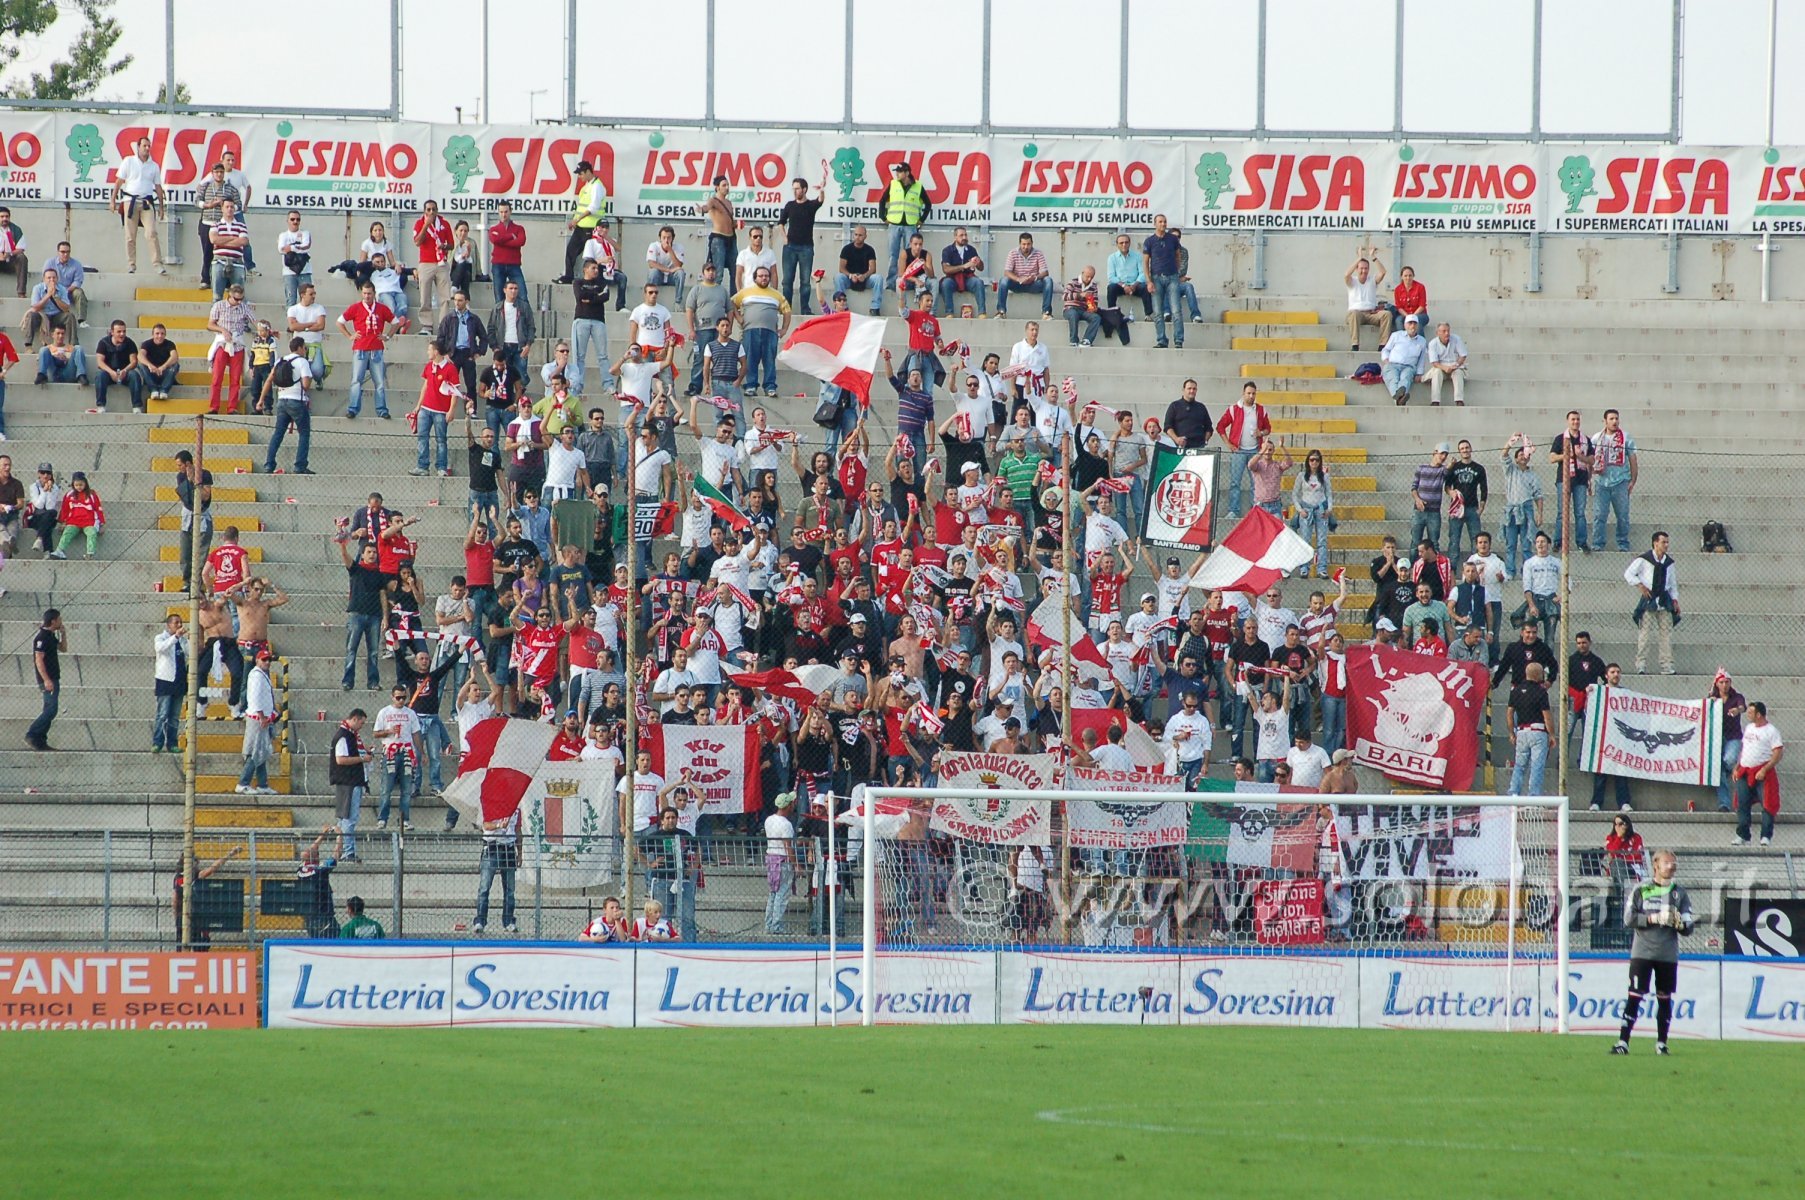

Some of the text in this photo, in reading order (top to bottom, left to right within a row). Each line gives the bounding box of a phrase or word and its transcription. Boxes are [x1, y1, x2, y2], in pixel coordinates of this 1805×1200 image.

[482, 138, 615, 197] SISA
[8, 171, 37, 183] SISA
[1233, 154, 1365, 211] SISA
[65, 187, 69, 199] I
[332, 181, 413, 194] gruppo SISA
[1596, 158, 1729, 215] SISA
[265, 194, 418, 210] LA SPESA PIÙ SEMPLICE
[701, 190, 782, 203] grpo SISA
[1073, 197, 1149, 209] gruppo SISA
[637, 205, 652, 216] LA
[657, 205, 696, 217] SPESA
[734, 207, 782, 219] EMPLIC
[938, 209, 991, 221] ITALIANI
[1451, 203, 1531, 214] gruppo SISA
[1013, 210, 1153, 224] LA SPESA PIÙ SEMPLICE
[1194, 214, 1364, 228] I SUPERMERCATI ITALIANI
[1388, 216, 1536, 230] LA SPESA PIÙ SEMPLICE
[1556, 218, 1728, 231] I SUPERMERCATI ITALIANI
[1753, 221, 1768, 231] LA
[1153, 539, 1201, 552] SANTERAMO
[1609, 696, 1702, 721] QUARTIERE
[684, 739, 726, 754] Kid
[692, 755, 718, 767] du
[1367, 746, 1433, 772] BARI
[1603, 744, 1698, 773] CARBONARA
[1070, 829, 1127, 848] SEMPRE
[1263, 885, 1317, 903] Simone
[1278, 904, 1306, 917] non
[291, 963, 610, 1011] Latteria Soresina
[658, 966, 810, 1014] Latteria
[1184, 968, 1335, 1016] Soresina
[92, 1003, 107, 1016] E
[125, 1002, 245, 1016] SPECIALI
